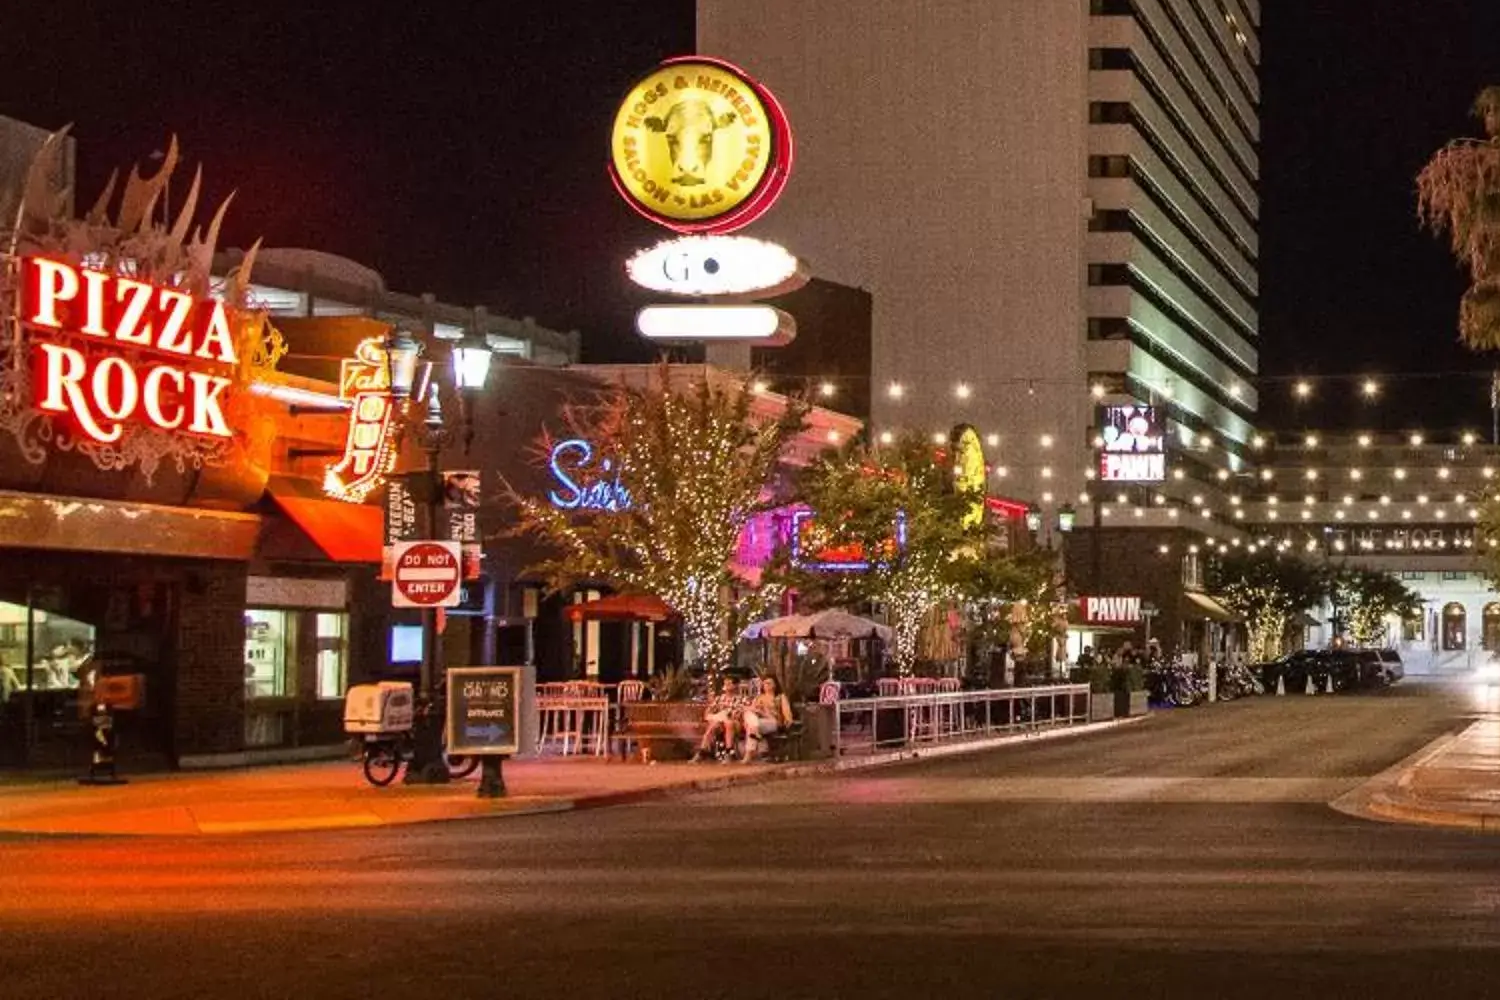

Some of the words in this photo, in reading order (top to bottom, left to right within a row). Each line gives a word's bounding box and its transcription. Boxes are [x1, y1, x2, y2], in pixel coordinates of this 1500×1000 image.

[626, 81, 669, 130] HOGS
[673, 74, 690, 91] &
[696, 74, 758, 128] HEIFERS
[31, 257, 240, 365] PIZZA
[40, 342, 234, 444] ROCK
[353, 396, 386, 475] OUT
[1107, 453, 1164, 479] PAWN
[404, 554, 421, 567] DO
[427, 554, 449, 567] NOT
[407, 582, 446, 594] ENTER
[1086, 596, 1141, 621] PAWN
